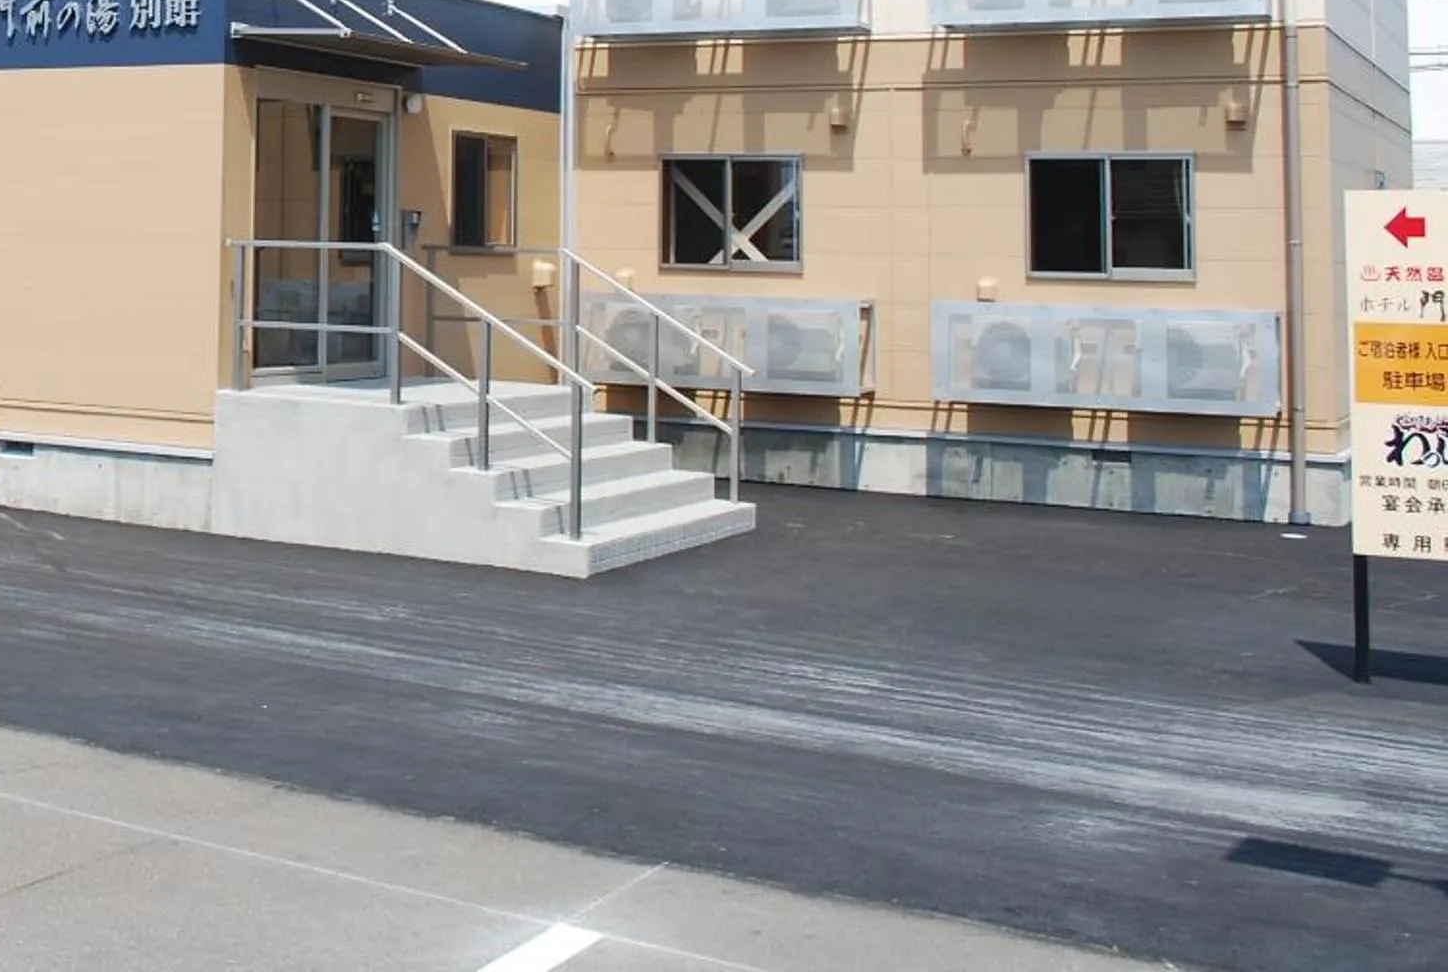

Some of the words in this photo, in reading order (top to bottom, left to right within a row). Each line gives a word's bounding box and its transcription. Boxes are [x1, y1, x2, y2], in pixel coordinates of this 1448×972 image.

[1360, 295, 1411, 312] ホテル
[1382, 371, 1445, 392] 駐車場
[1382, 533, 1448, 553] 専用
